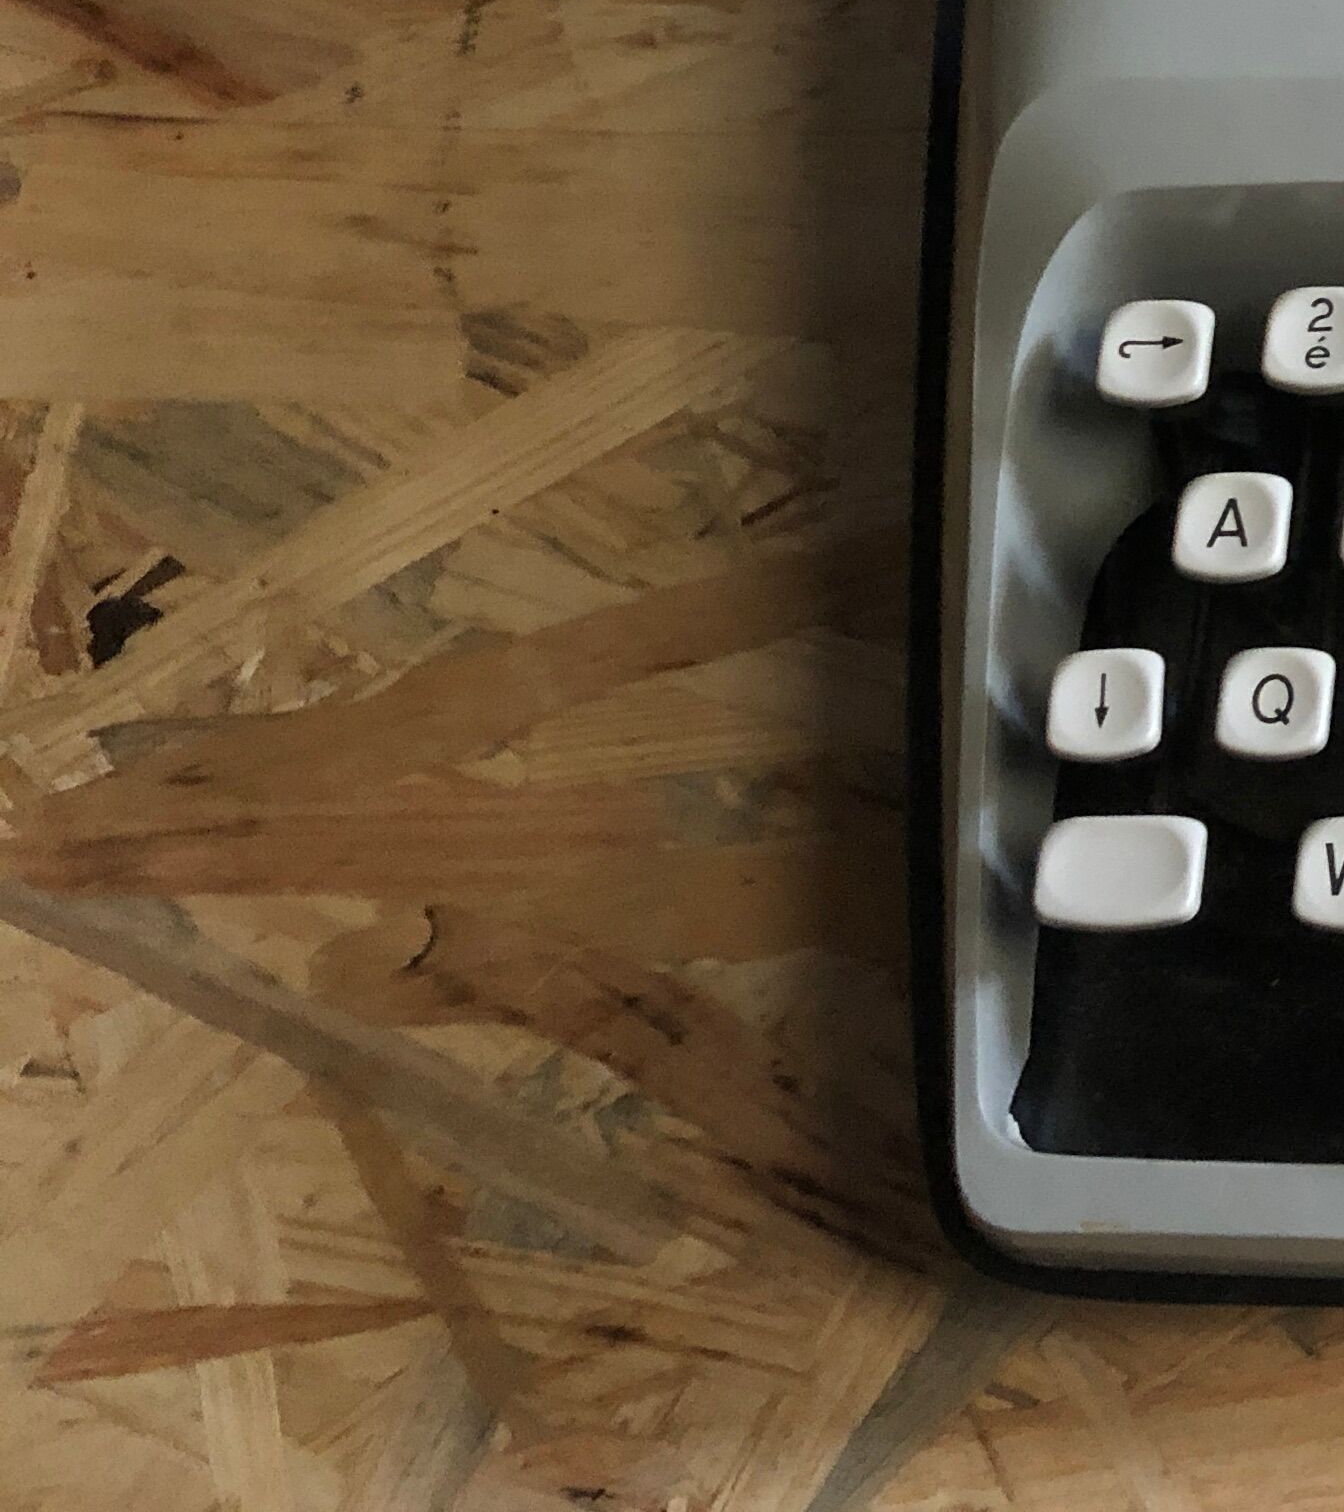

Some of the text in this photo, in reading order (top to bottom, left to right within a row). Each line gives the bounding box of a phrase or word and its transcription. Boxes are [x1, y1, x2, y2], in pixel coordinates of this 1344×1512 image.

[1307, 297, 1334, 333] 2
[1304, 335, 1331, 369] é
[1206, 497, 1248, 548] A
[1251, 673, 1295, 726] Q
